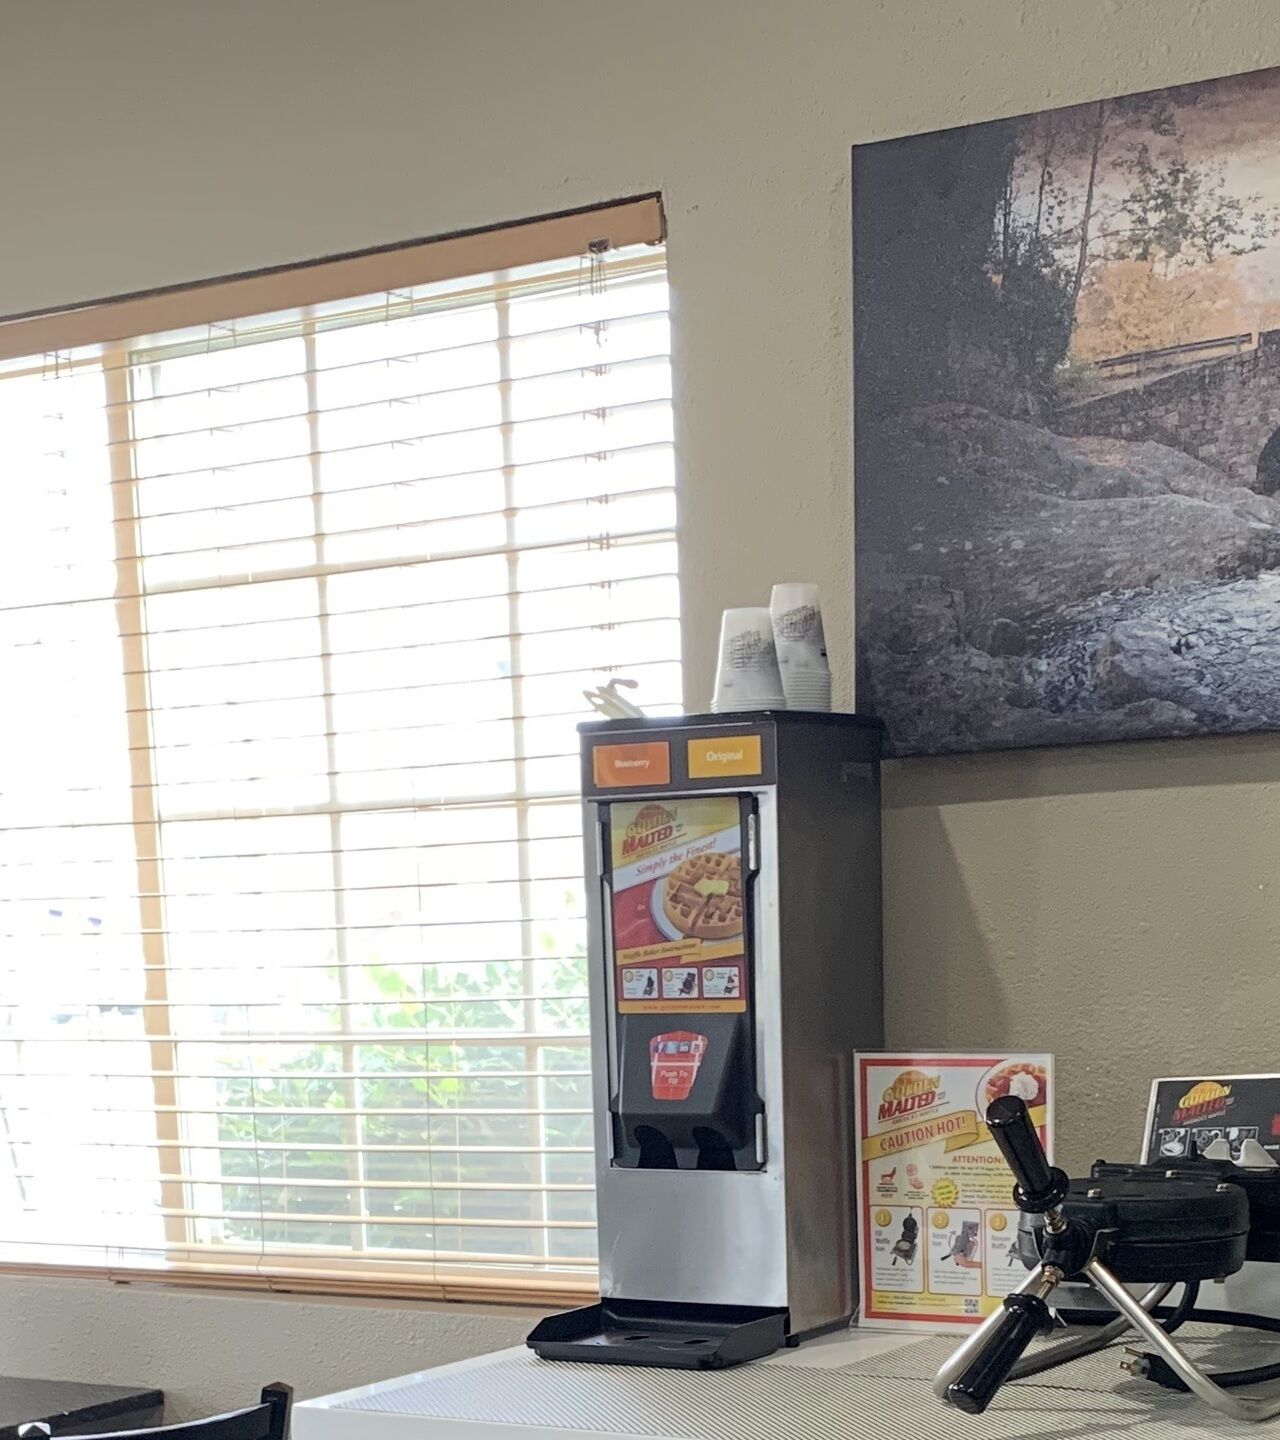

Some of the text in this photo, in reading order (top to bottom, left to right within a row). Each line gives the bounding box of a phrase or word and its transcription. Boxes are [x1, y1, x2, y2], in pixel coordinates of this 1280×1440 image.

[706, 749, 743, 764] Original
[622, 824, 674, 855] MALTED
[636, 857, 667, 876] Simply
[669, 851, 684, 864] the
[686, 837, 717, 857] Finest!
[882, 1074, 941, 1103] GOLDEN
[878, 1090, 936, 1121] MALTED
[880, 1116, 967, 1151] CAUTION HOT!
